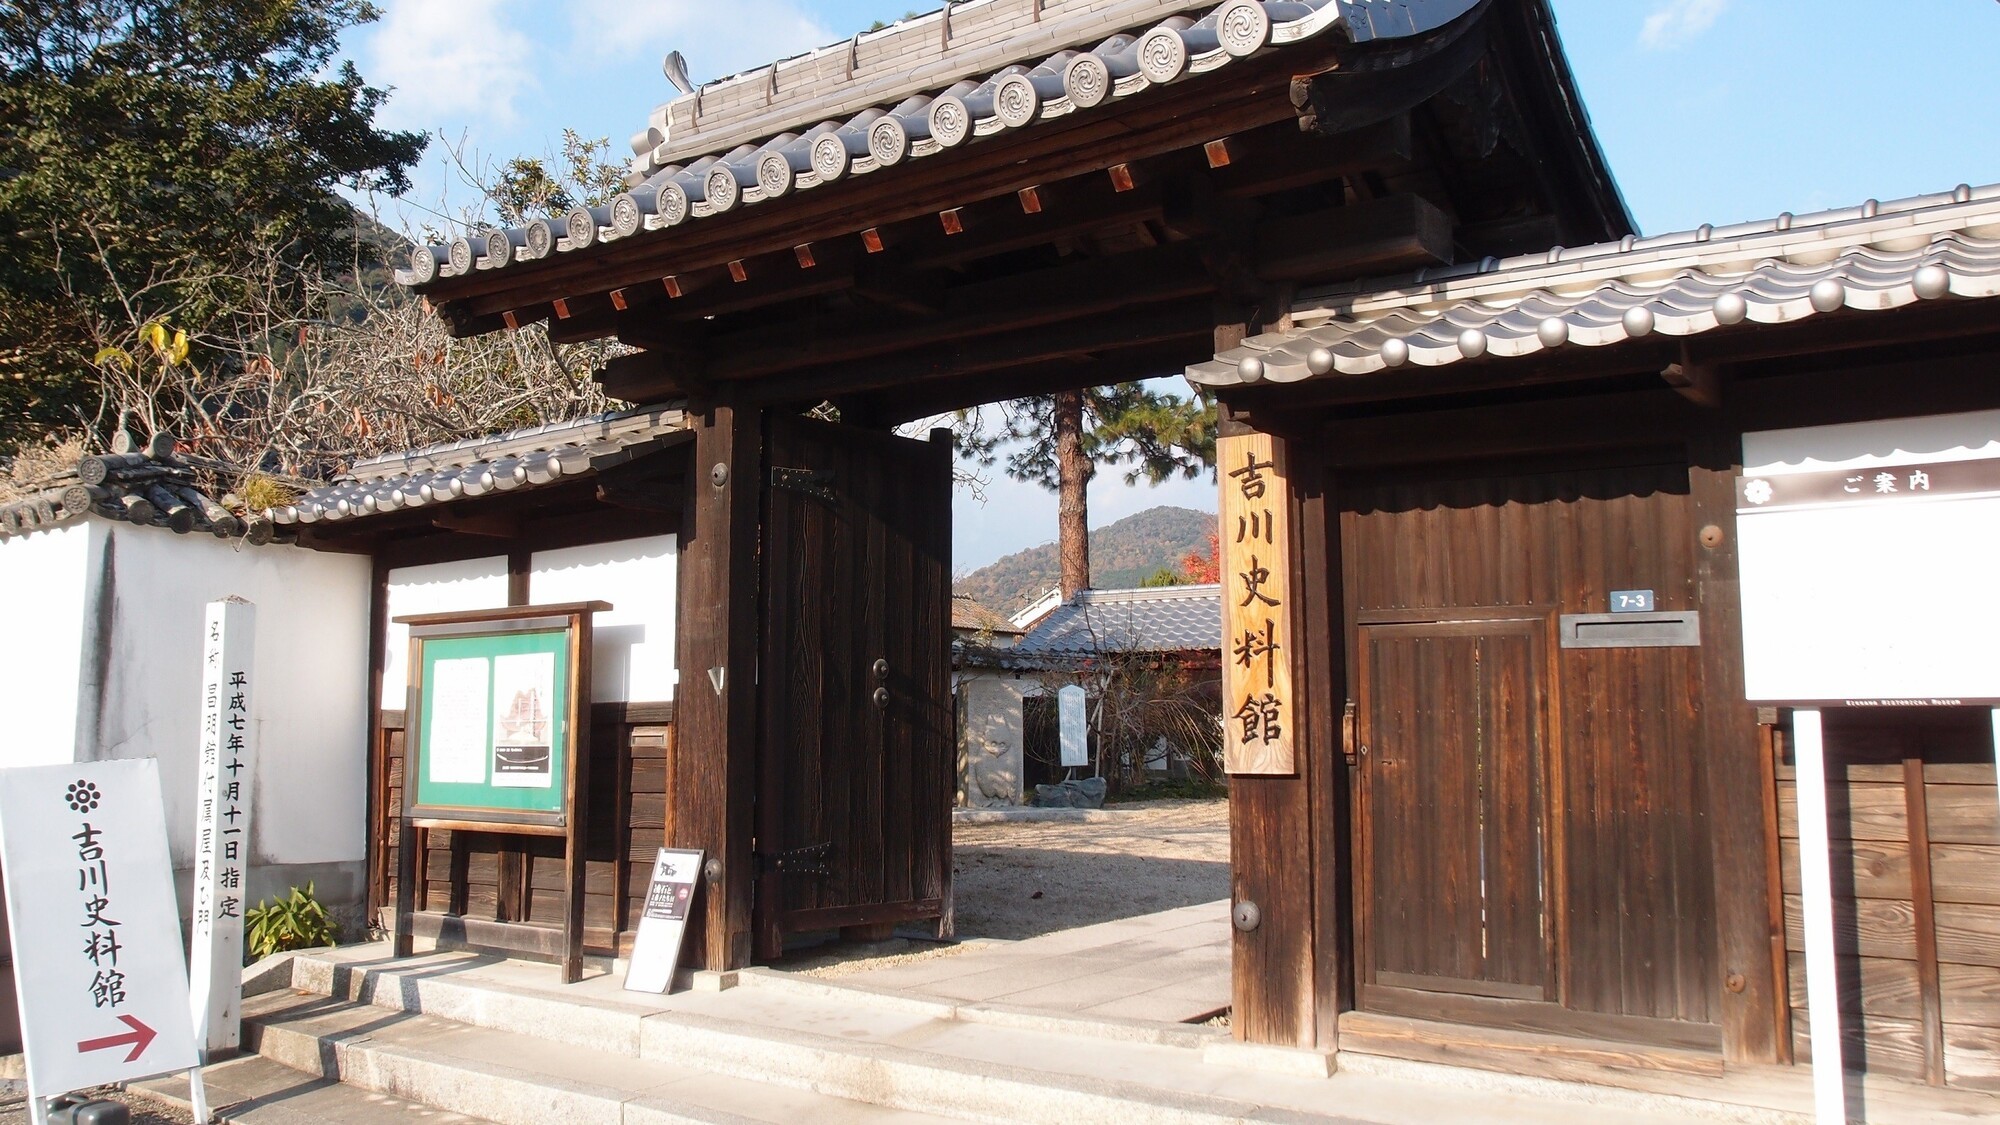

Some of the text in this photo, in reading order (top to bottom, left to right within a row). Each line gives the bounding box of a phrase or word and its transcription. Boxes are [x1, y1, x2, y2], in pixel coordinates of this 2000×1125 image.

[1843, 469, 1930, 494] ご案内
[1228, 451, 1282, 746] 吉川史料館
[1619, 594, 1645, 608] 7-3
[218, 671, 247, 919] 平成七年十月十一日指定
[72, 823, 126, 1008] 吉川史料館
